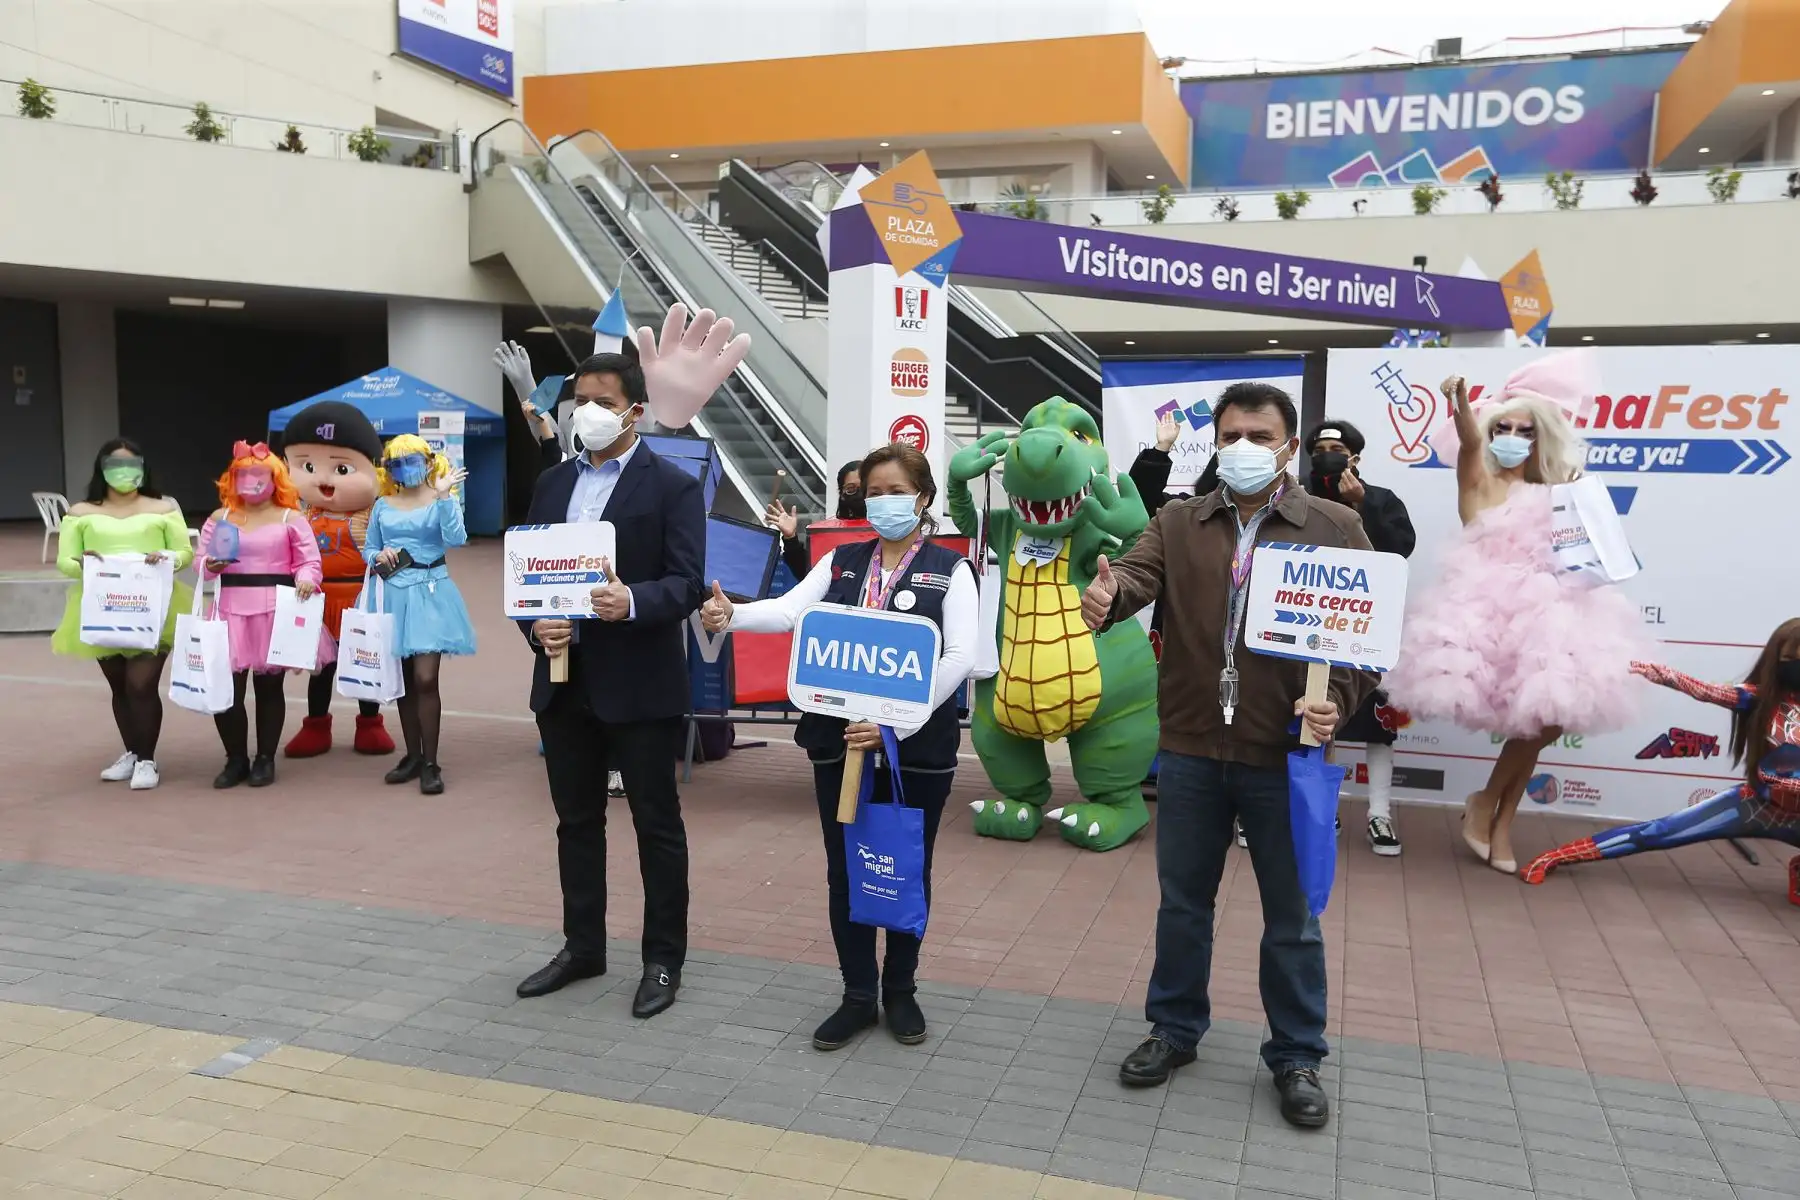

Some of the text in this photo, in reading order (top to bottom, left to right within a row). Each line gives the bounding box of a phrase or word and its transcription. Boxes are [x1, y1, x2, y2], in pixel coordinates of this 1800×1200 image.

[1266, 84, 1585, 139] BIENVENIDOS
[888, 216, 935, 236] PLAZA
[885, 232, 939, 247] DE COMIDAS
[1058, 236, 1397, 309] Visítanos en el 3er nivel
[900, 319, 923, 330] KFC
[891, 362, 929, 374] BURGER
[891, 373, 929, 389] KING
[1180, 441, 1206, 457] SAN
[1637, 443, 1690, 471] ya!
[527, 555, 609, 572] VacunaFest
[540, 573, 587, 584] ¡Vacúnate ya!
[1283, 560, 1370, 593] MINSA
[106, 593, 131, 601] Vamos
[1274, 588, 1374, 615] más cerca
[1323, 612, 1374, 635] de tí
[805, 636, 923, 681] MINSA
[865, 861, 894, 875] miguel
[879, 855, 894, 865] san
[886, 888, 898, 896] más!
